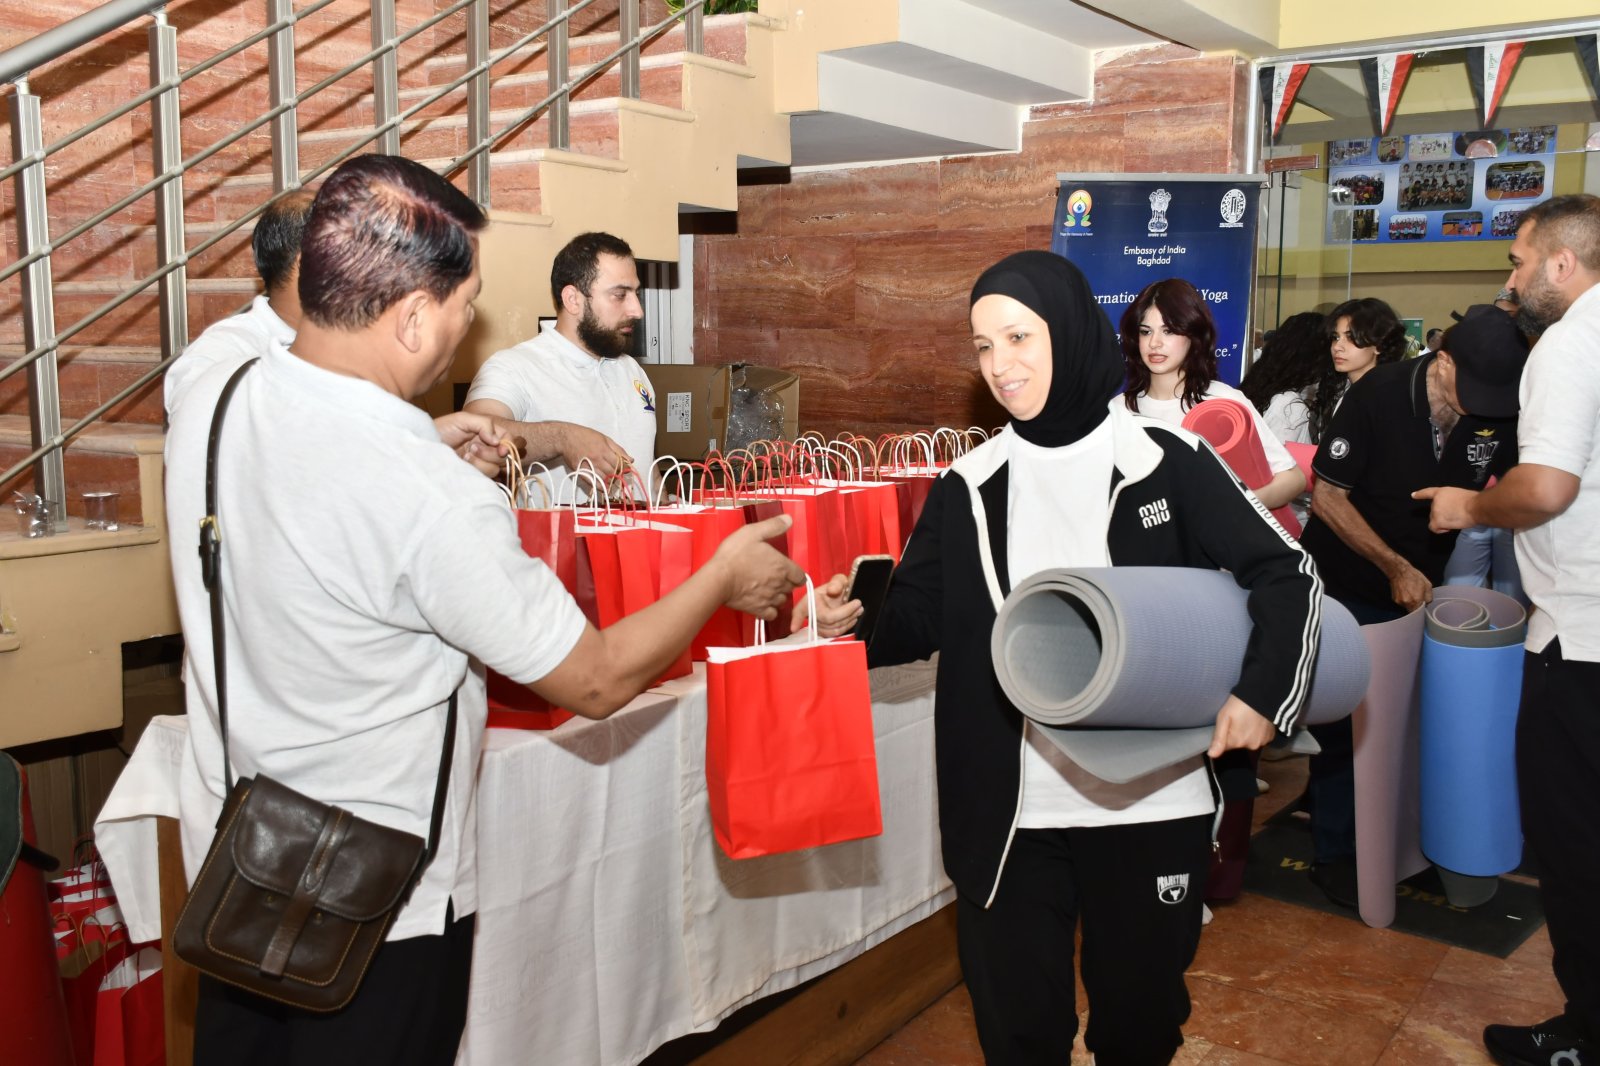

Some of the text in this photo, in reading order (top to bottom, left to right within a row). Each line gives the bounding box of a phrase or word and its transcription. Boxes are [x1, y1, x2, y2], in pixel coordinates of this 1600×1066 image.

[1123, 245, 1186, 257] Embassy of India
[1137, 255, 1171, 267] Baghdad
[1200, 289, 1229, 304] Yoga
